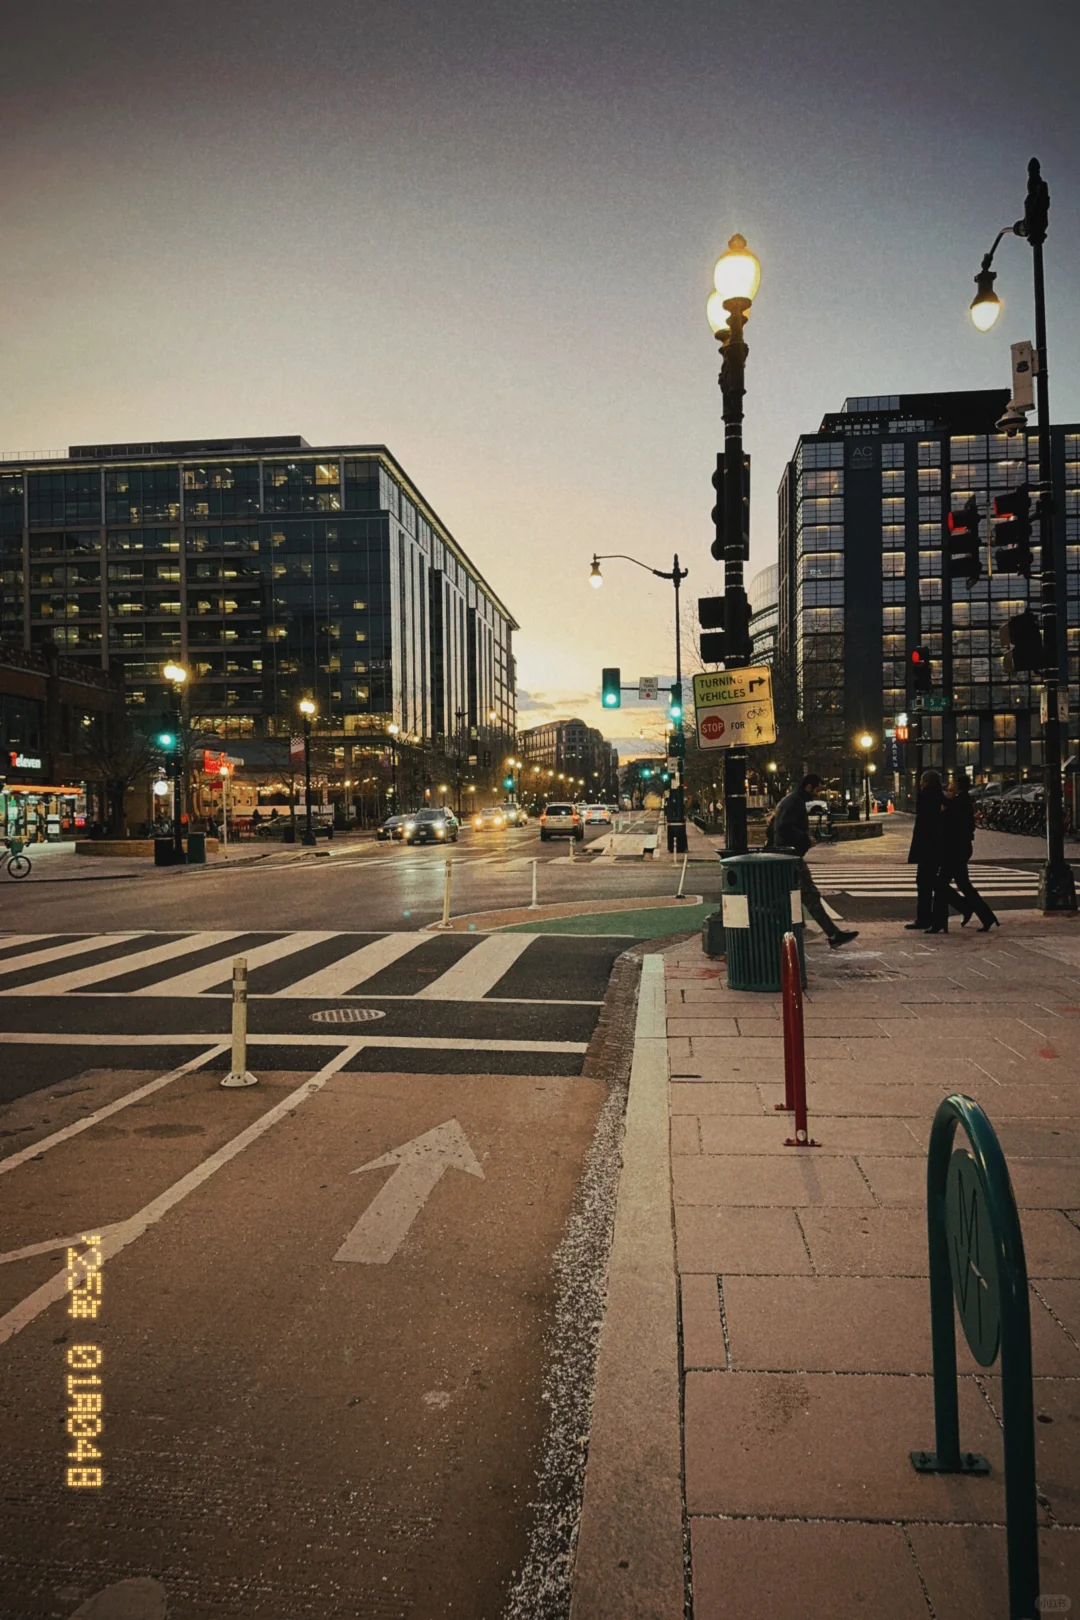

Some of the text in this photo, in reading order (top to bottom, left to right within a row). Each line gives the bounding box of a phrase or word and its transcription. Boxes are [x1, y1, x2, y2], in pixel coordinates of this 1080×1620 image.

[699, 675, 743, 689] TURNING
[699, 688, 746, 702] VEHICLES
[701, 721, 745, 734] STOP FOR
